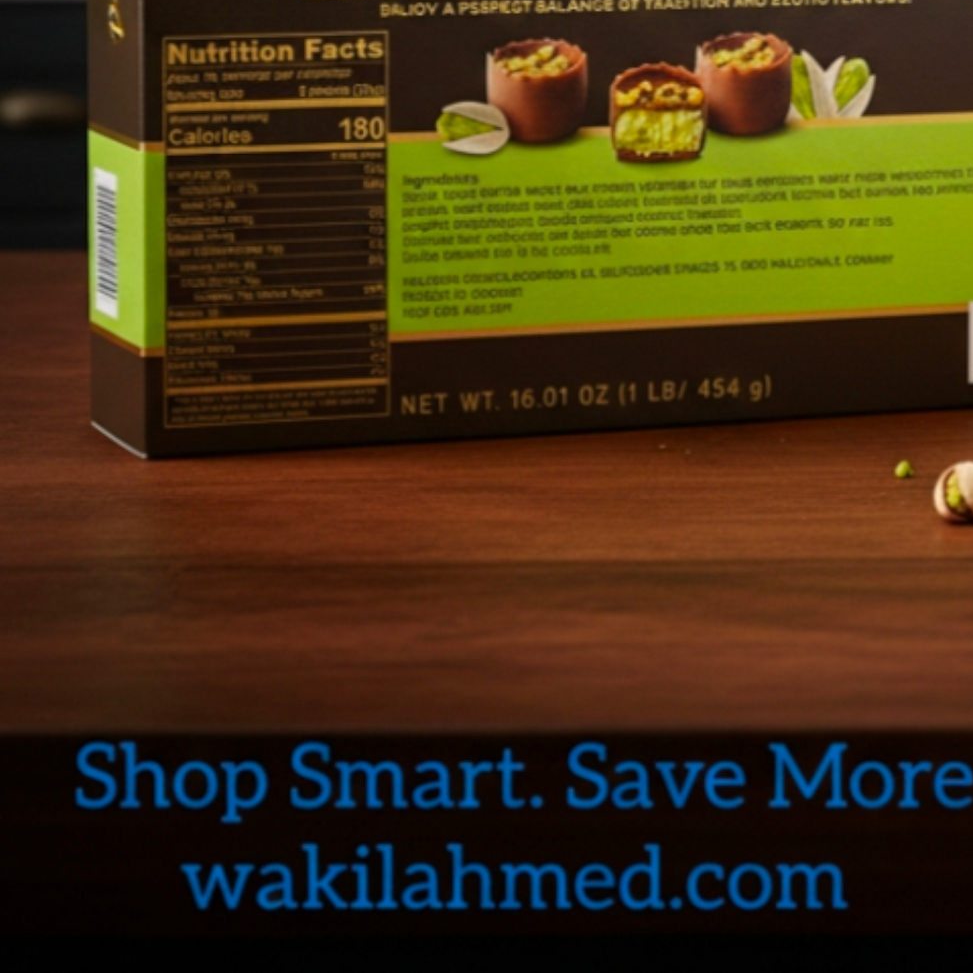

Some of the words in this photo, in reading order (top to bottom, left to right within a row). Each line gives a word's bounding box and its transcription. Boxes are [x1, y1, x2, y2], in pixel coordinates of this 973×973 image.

[167, 40, 294, 65] Nutrition
[304, 38, 384, 61] Facts
[338, 116, 385, 141] 180
[401, 393, 448, 415] NET
[459, 390, 500, 413] WT.
[511, 386, 569, 409] 16.01
[698, 377, 740, 400] 454
[749, 374, 772, 401] g)
